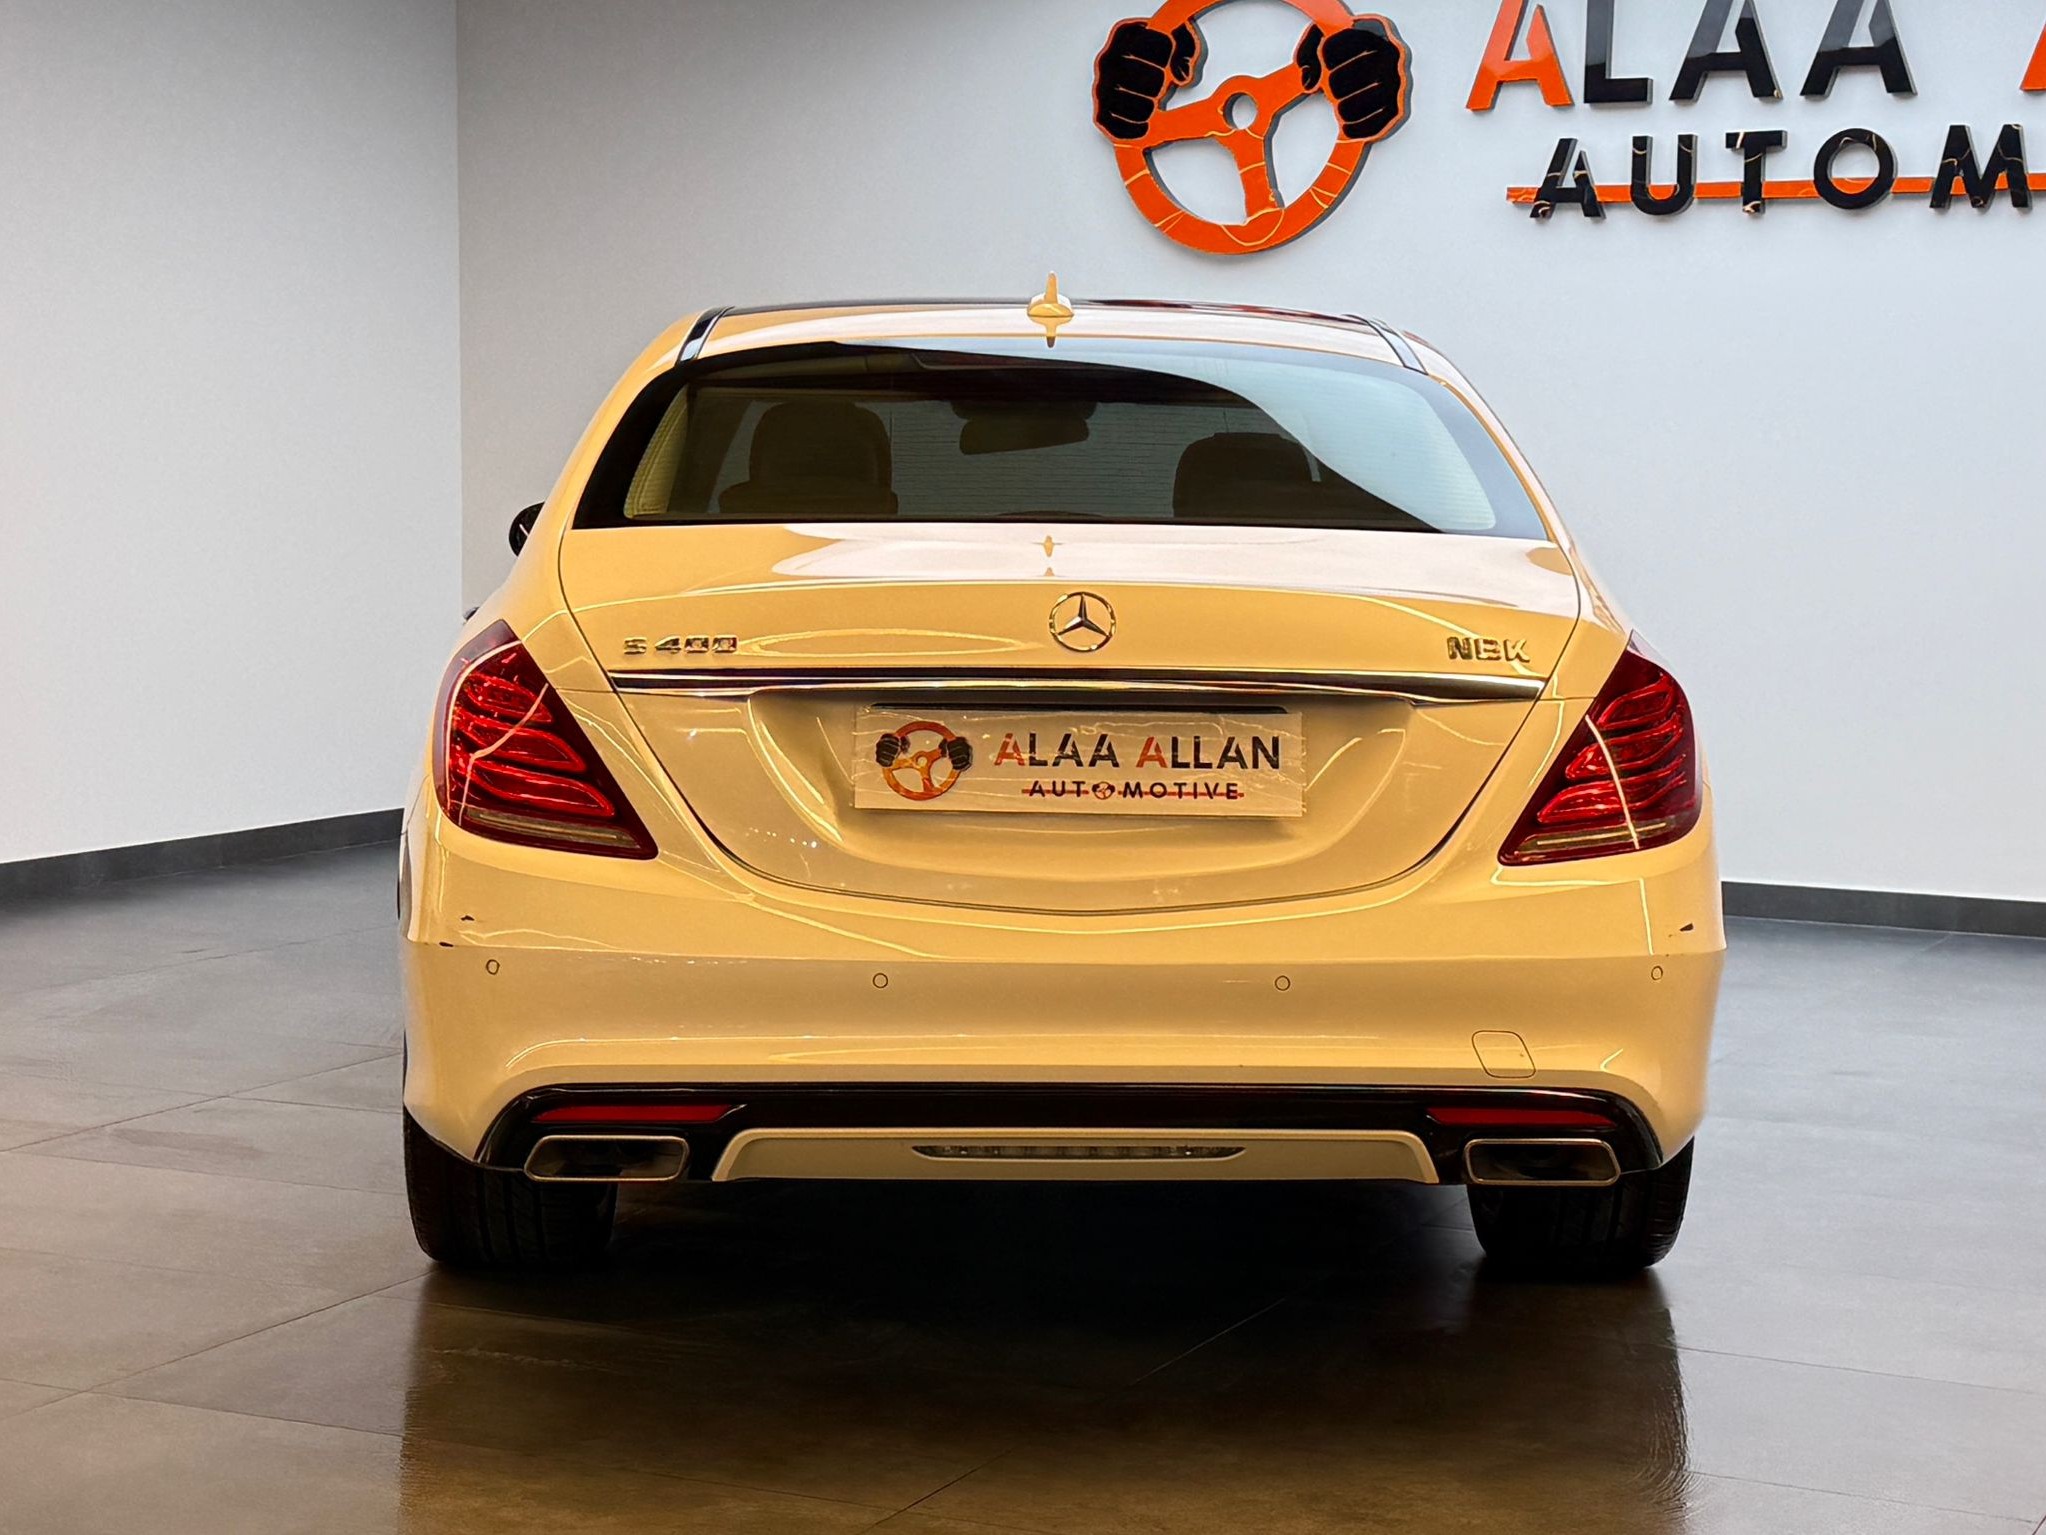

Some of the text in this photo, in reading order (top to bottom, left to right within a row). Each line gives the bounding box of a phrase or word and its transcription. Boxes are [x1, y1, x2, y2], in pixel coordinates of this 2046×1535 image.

[1466, 0, 1918, 110] ALAA
[1530, 123, 2034, 218] AUTOM
[624, 634, 738, 655] S 400
[994, 732, 1280, 770] ALAA ALLAN
